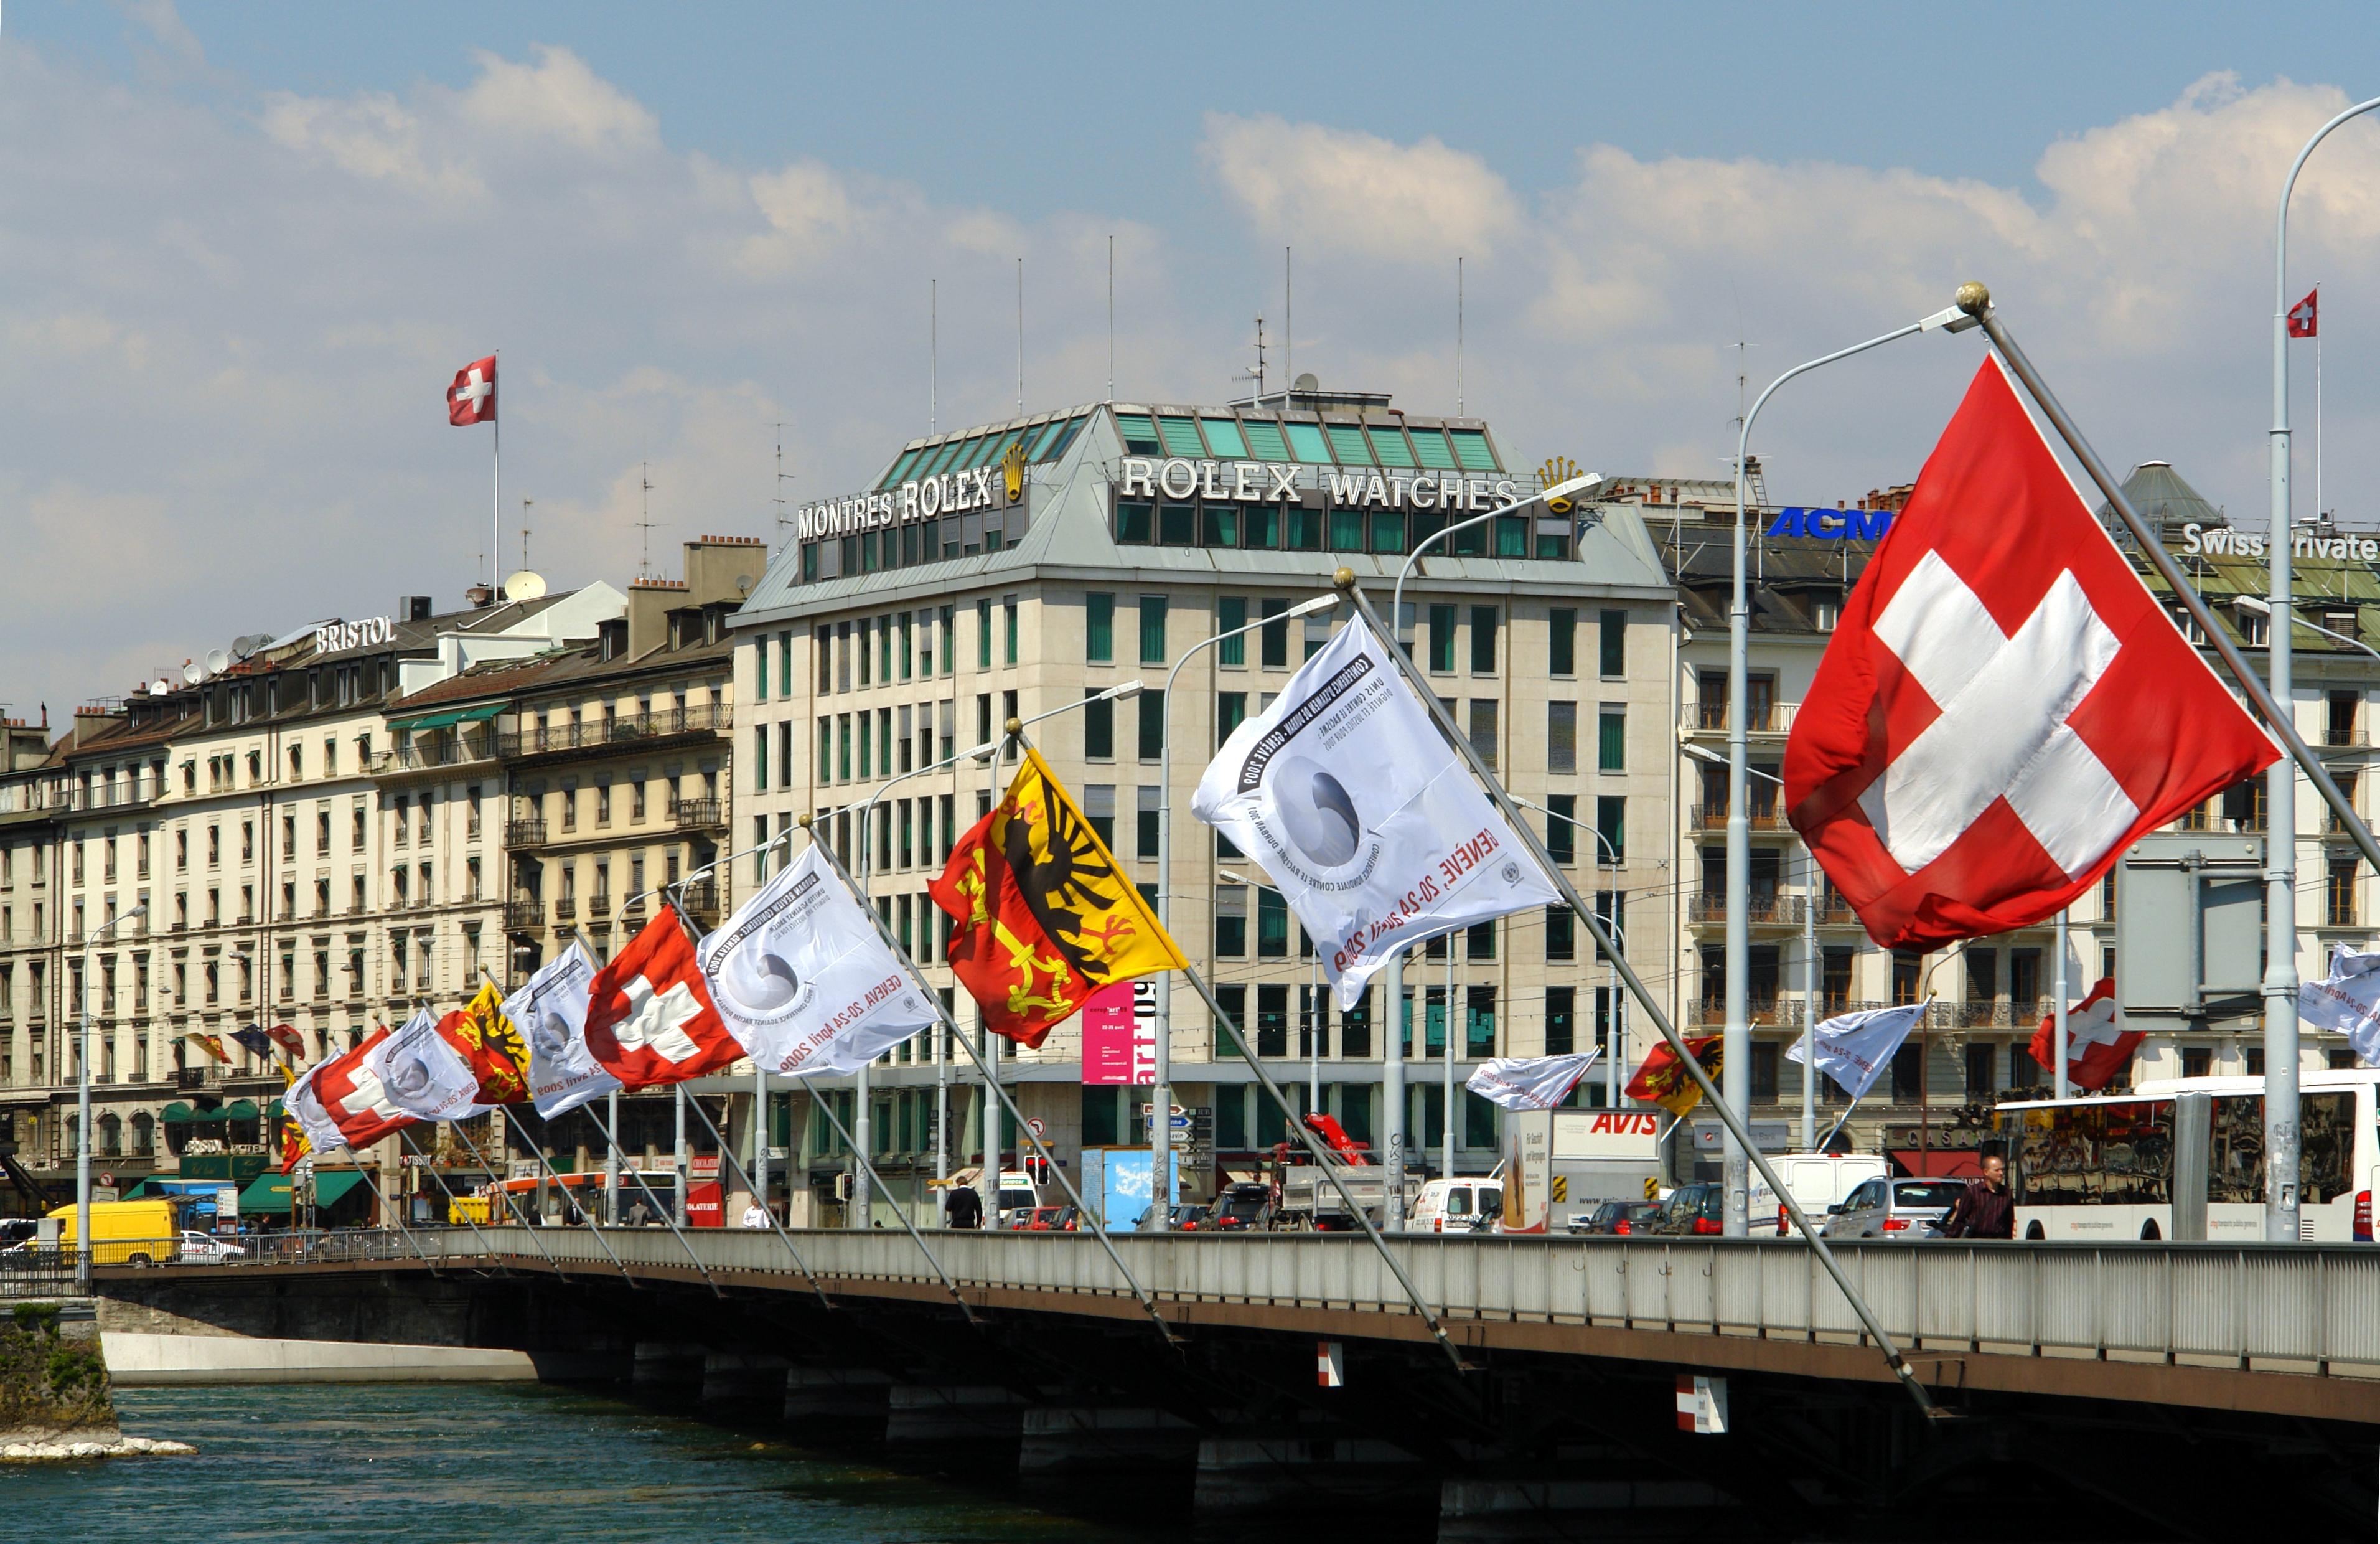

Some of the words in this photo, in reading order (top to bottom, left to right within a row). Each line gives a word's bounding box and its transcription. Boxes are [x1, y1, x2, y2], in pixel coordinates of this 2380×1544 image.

[798, 492, 892, 539] MONTRES
[902, 466, 991, 520] ROLEX
[1121, 456, 1302, 502] ROLEX
[1328, 473, 1519, 511] WATCHES
[2183, 523, 2264, 556] Swiss
[2291, 528, 2378, 560] rivate
[316, 615, 398, 654] BRISTOL
[1590, 1113, 1657, 1136] AVIS
